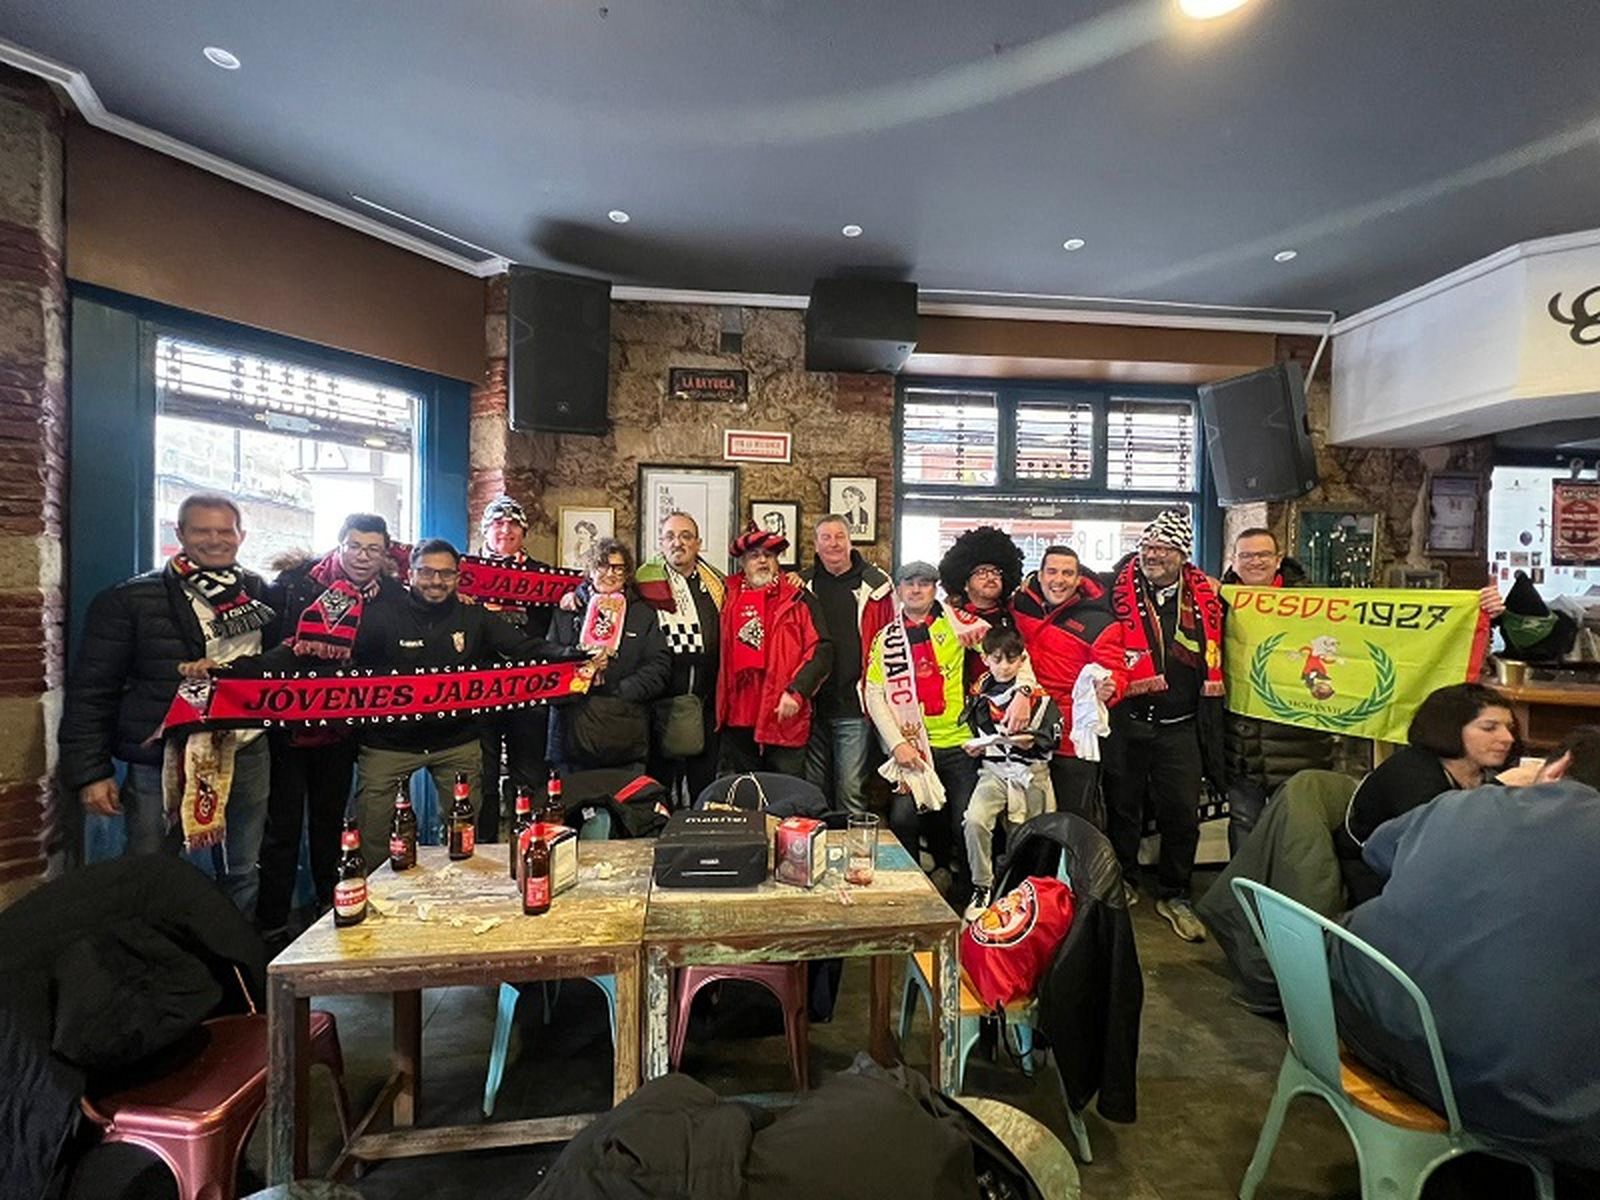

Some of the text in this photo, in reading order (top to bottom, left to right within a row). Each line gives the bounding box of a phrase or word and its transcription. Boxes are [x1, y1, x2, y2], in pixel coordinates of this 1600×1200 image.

[480, 575, 578, 598] JABATO
[1233, 591, 1350, 622] DESDE
[1353, 601, 1453, 631] 1927
[336, 669, 374, 678] SOY
[390, 668, 399, 676] A
[415, 664, 478, 675] MUCHA
[244, 670, 561, 713] JÓVENES JABATOS
[263, 698, 548, 727] DE LA CIUDAD DE MIRANDA
